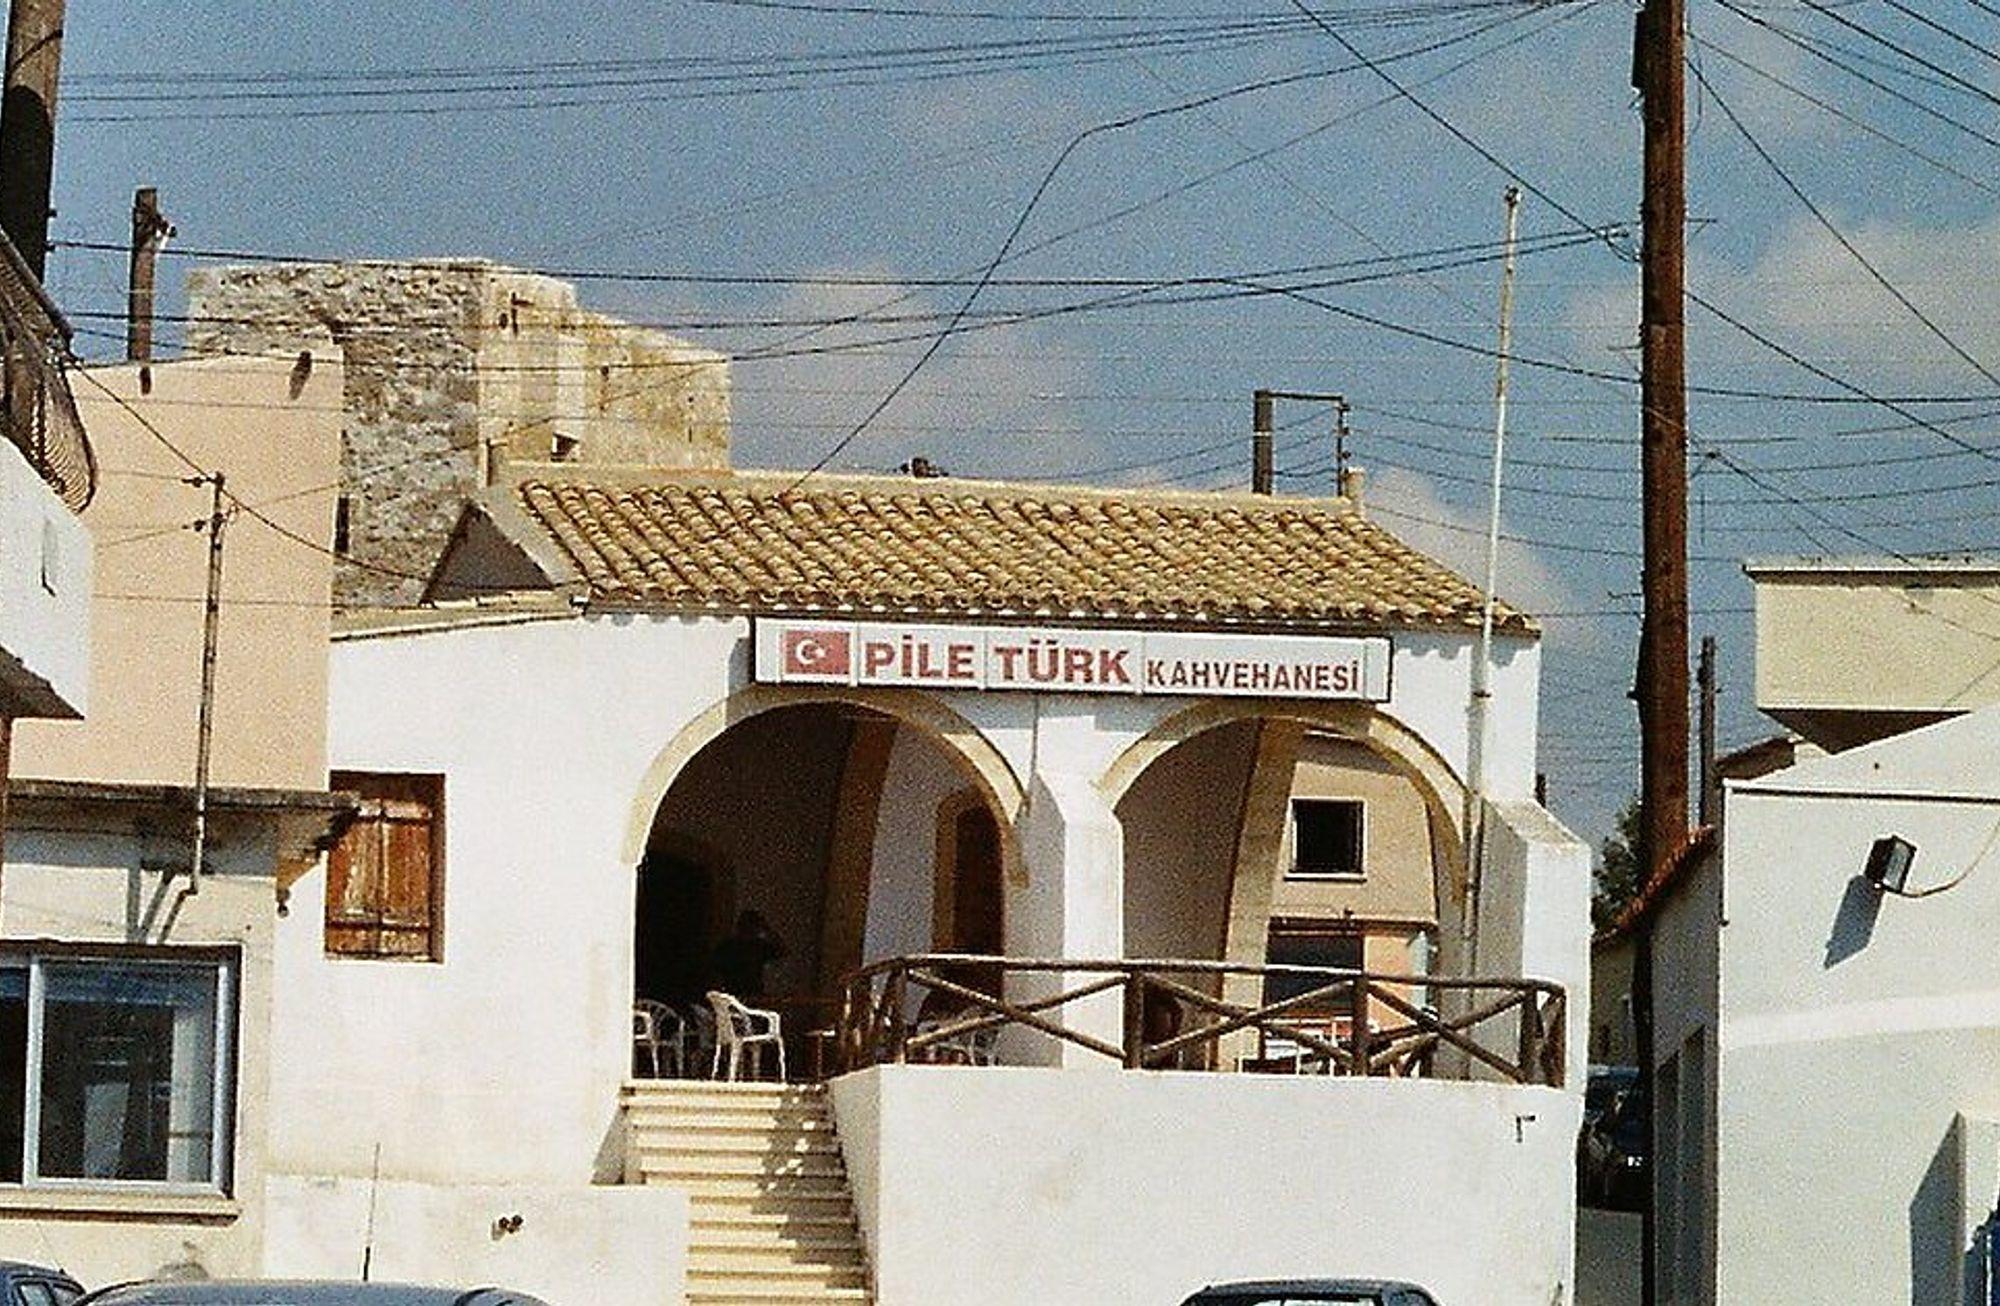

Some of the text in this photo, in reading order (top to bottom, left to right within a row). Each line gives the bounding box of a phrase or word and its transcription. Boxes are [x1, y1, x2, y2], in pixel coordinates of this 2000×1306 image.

[866, 635, 1359, 692] PİLE TÜRK KAHVEHANESİ
